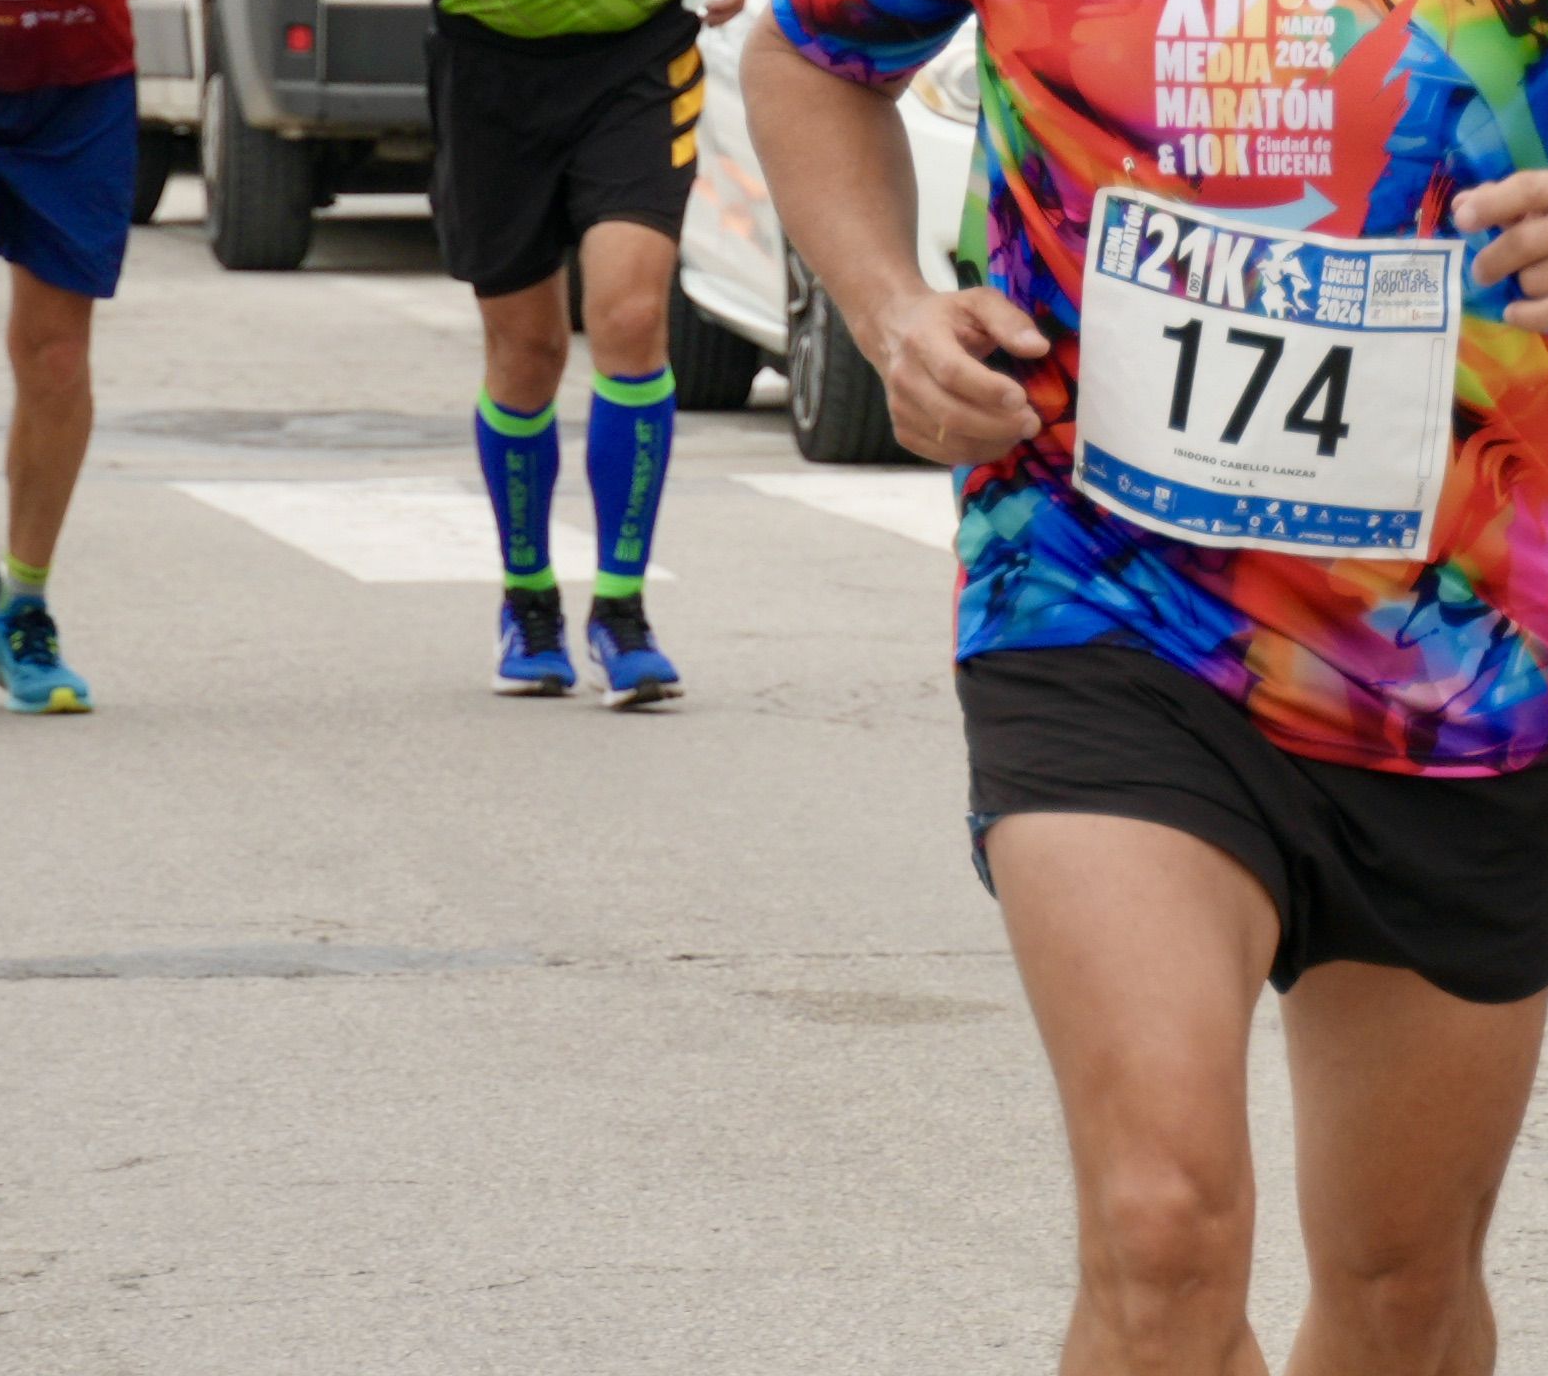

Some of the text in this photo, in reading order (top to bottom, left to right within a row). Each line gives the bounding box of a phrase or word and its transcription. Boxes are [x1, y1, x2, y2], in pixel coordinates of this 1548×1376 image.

[1275, 15, 1336, 37] MARZO
[1155, 40, 1272, 84] MEDIA
[1275, 39, 1335, 69] 2026
[1155, 78, 1334, 131] MARATÓN
[1158, 133, 1251, 177] & 10K
[1255, 135, 1332, 154] Ciudad de
[1256, 153, 1332, 177] LUCENA
[1136, 212, 1255, 310] 21K
[1374, 268, 1429, 283] carreras
[1372, 279, 1439, 297] populares
[1315, 297, 1362, 325] 2026
[1163, 317, 1354, 457] 174
[1173, 446, 1317, 479] ISIDORO CABELLO LANZAS
[1211, 475, 1241, 488] TALLA
